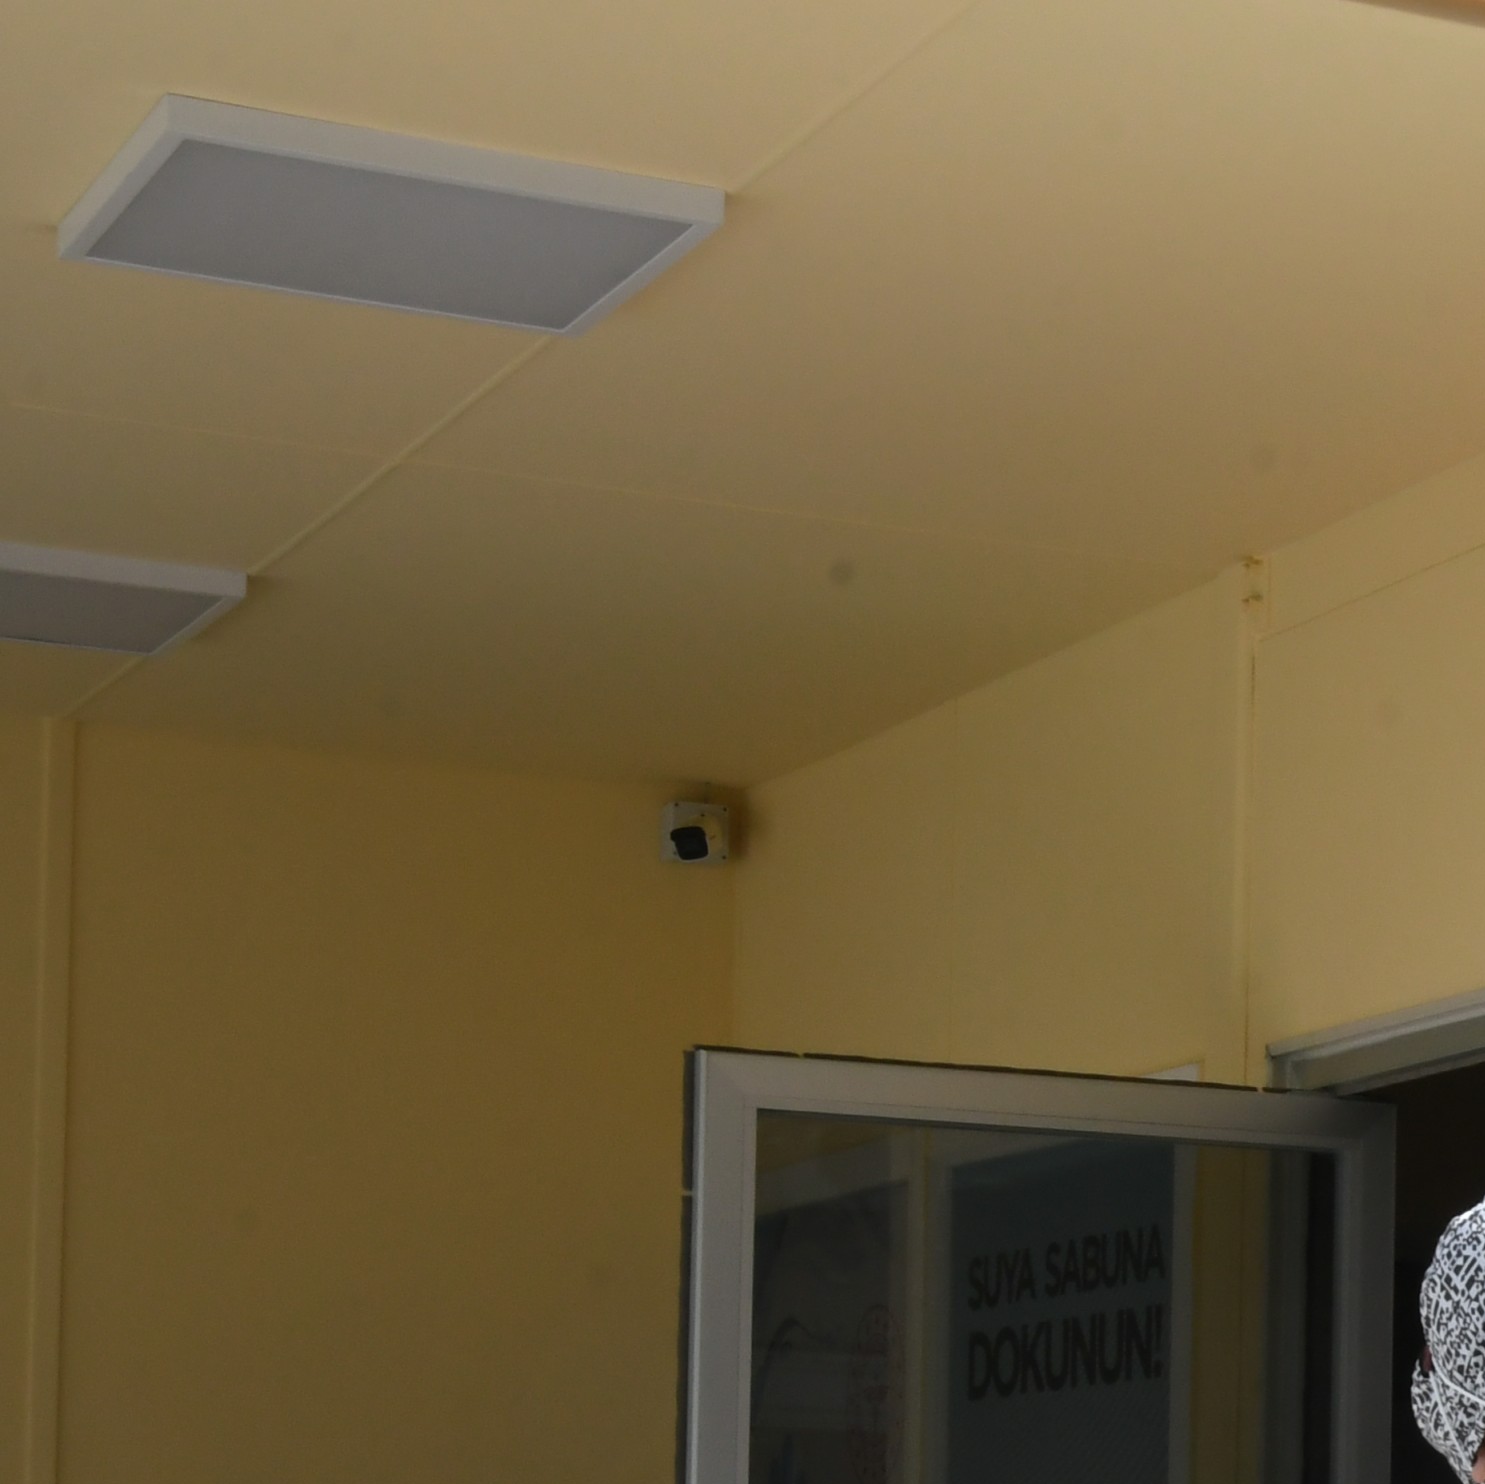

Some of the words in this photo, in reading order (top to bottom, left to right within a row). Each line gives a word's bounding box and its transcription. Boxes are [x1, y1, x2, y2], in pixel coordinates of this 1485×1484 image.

[966, 1248, 1038, 1311] SUYA
[1045, 1223, 1168, 1299] SABUNA
[967, 1305, 1165, 1401] DOKUNUN!
